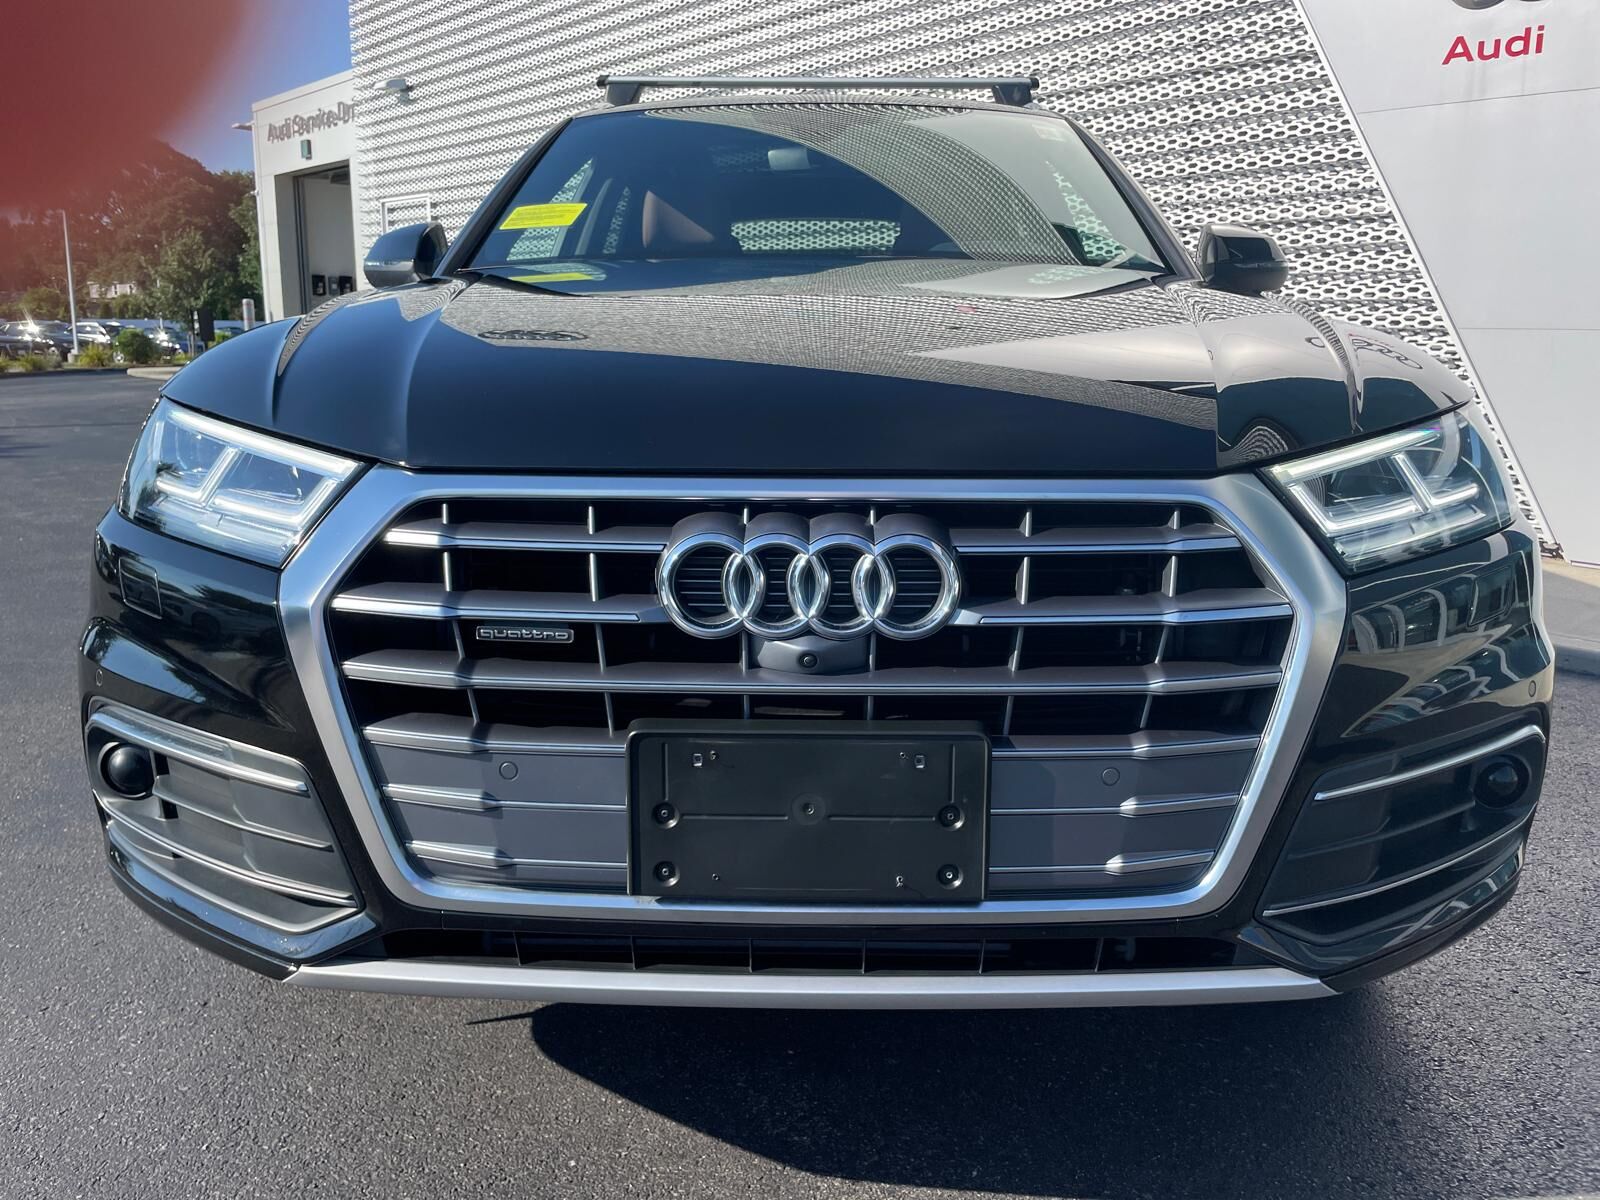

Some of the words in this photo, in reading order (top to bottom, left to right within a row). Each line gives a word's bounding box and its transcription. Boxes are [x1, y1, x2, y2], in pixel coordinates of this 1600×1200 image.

[1442, 24, 1545, 65] Audi
[267, 117, 292, 143] Audi
[480, 628, 569, 640] quattro
